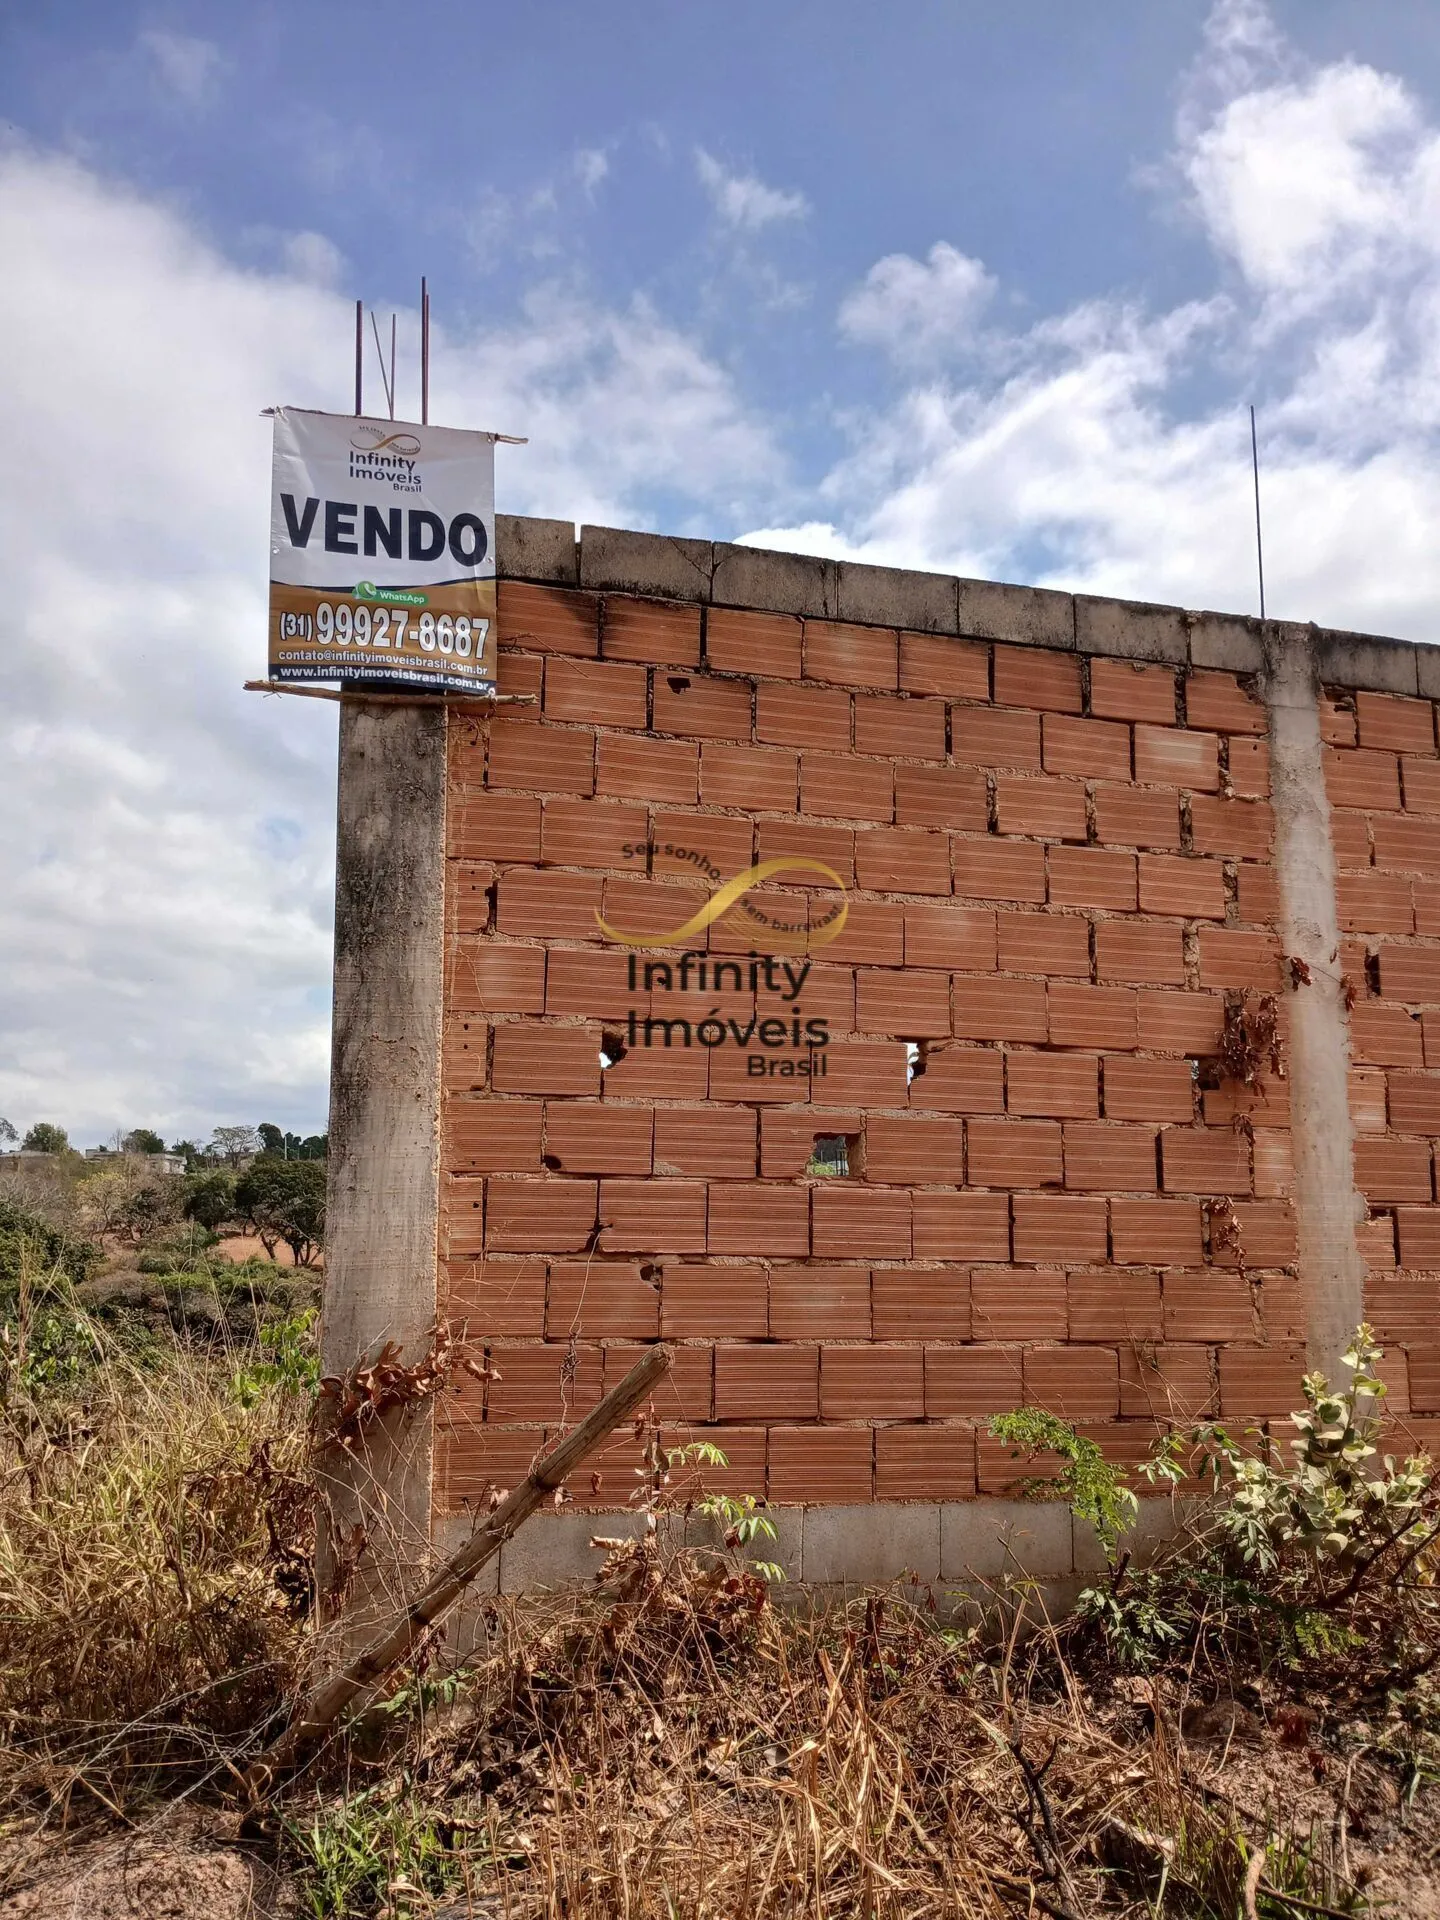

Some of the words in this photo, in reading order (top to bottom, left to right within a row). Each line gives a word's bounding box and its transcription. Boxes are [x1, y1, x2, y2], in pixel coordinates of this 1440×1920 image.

[349, 450, 416, 473] Infinity
[349, 465, 422, 485] Imóveis
[393, 483, 422, 493] Brasil
[279, 493, 488, 567] VENDO
[379, 591, 425, 604] WhatsApp
[279, 611, 313, 642] (31)
[315, 602, 490, 659] 99927-8687
[278, 649, 488, 676] contato@infinityimoveisbrasil.com.br
[280, 665, 489, 691] www.infinityimoveisbrasil.com.br
